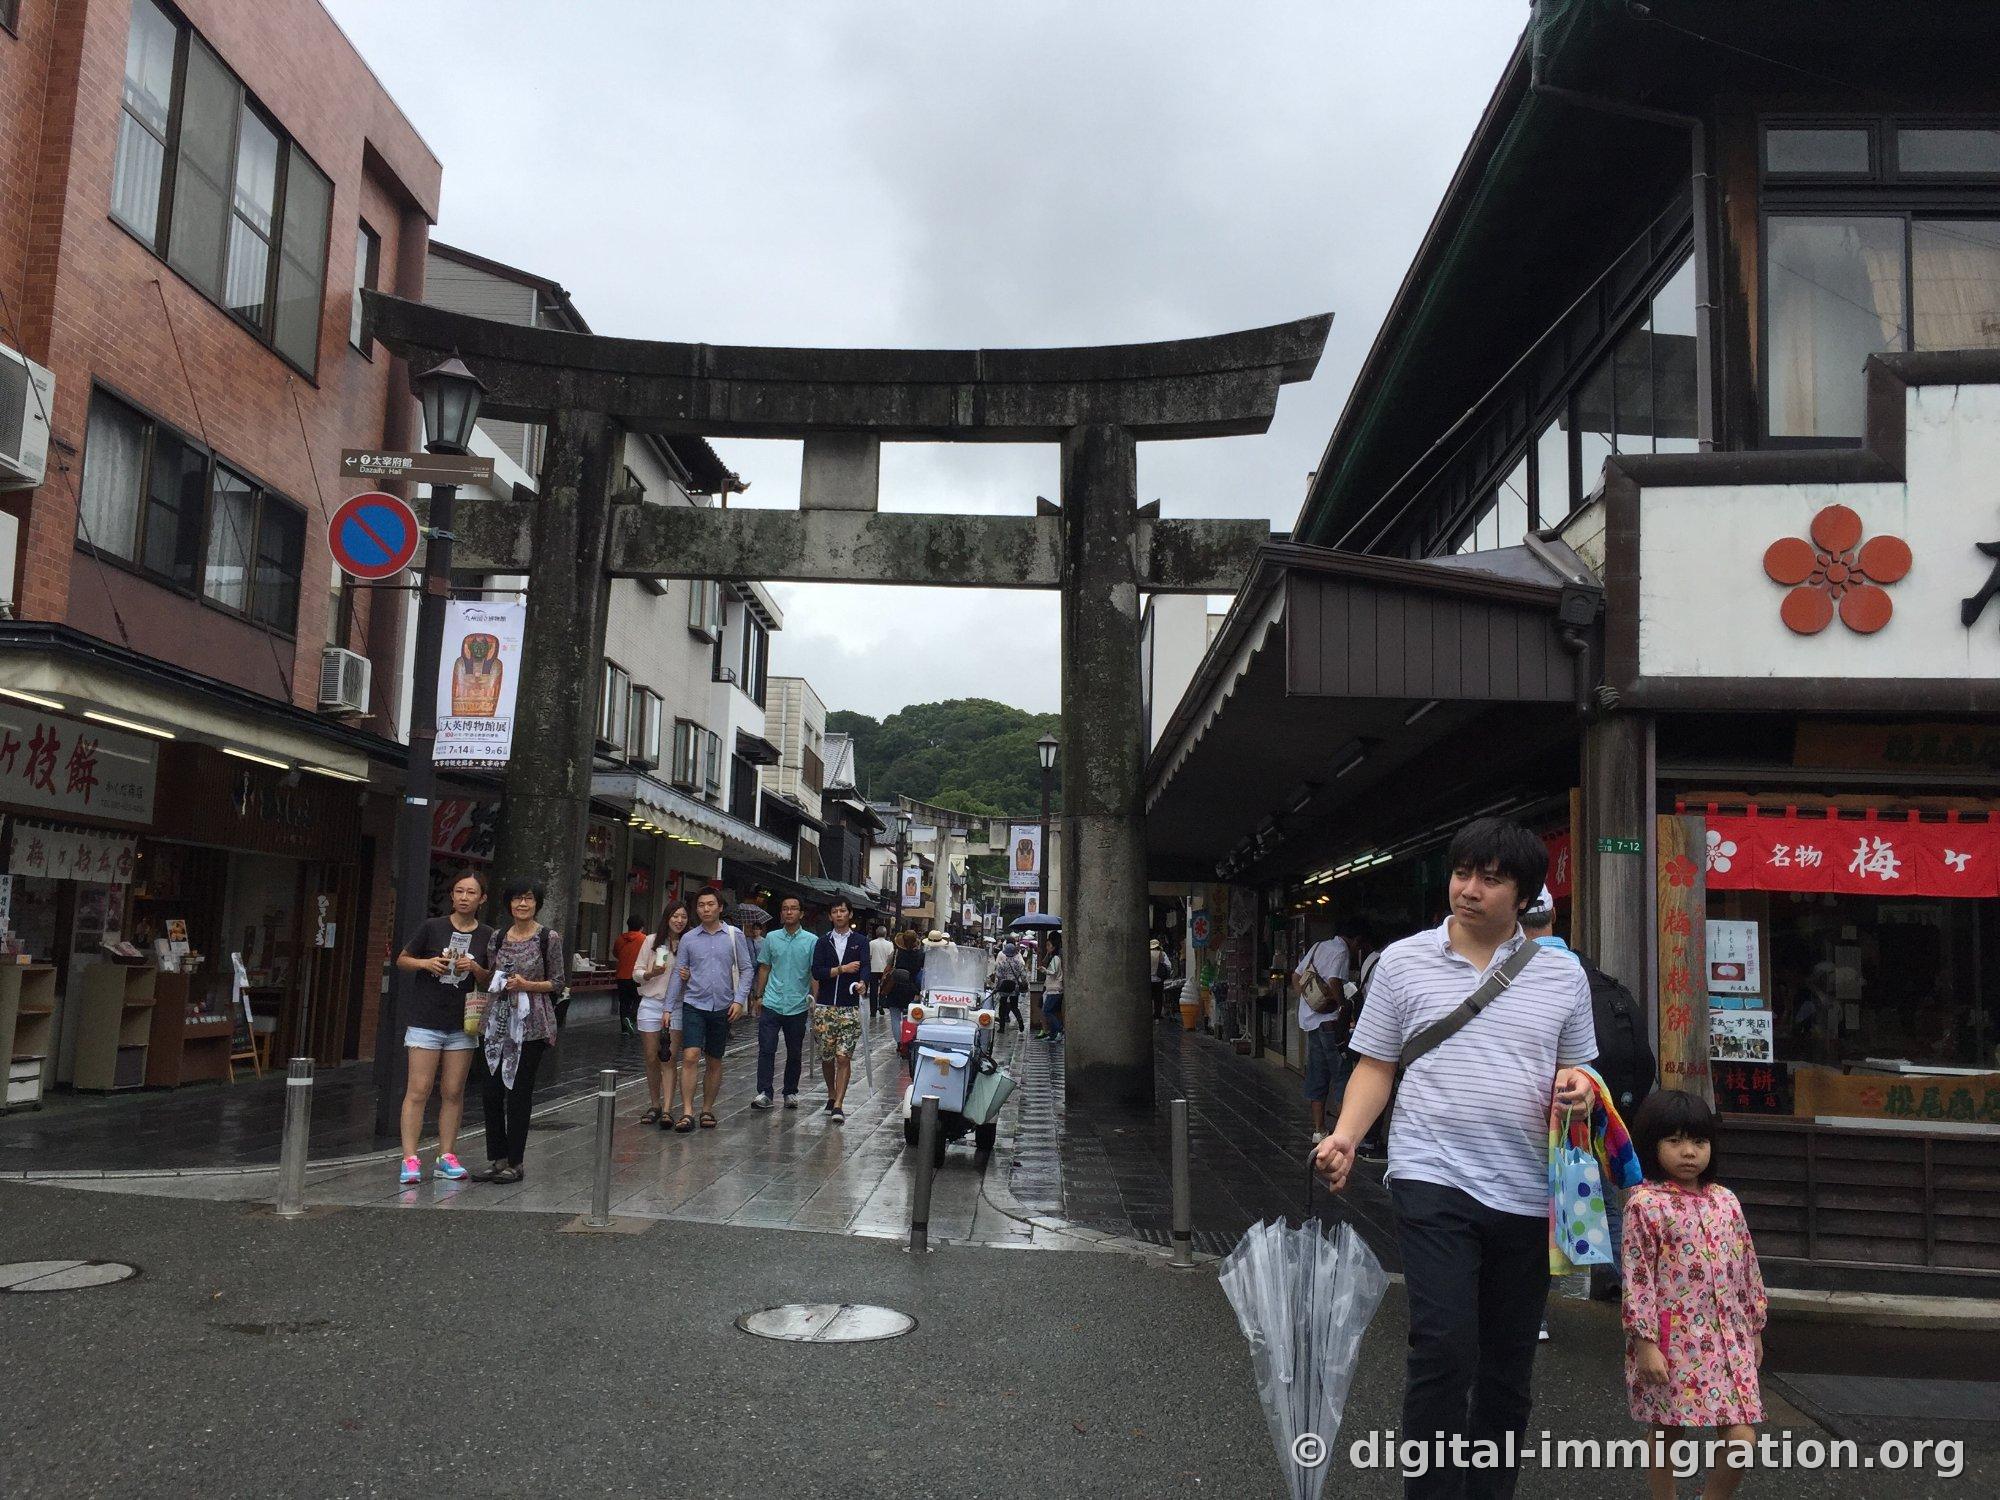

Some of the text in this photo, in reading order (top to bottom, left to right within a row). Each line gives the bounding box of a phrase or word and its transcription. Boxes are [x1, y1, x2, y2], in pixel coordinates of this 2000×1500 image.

[372, 456, 413, 468] 太宰府館
[360, 466, 385, 475] Dazaifu
[443, 720, 507, 732] 大英博物館展
[1617, 841, 1640, 851] 7-12
[1766, 843, 1823, 868] 名物
[934, 993, 972, 1004] Yakult
